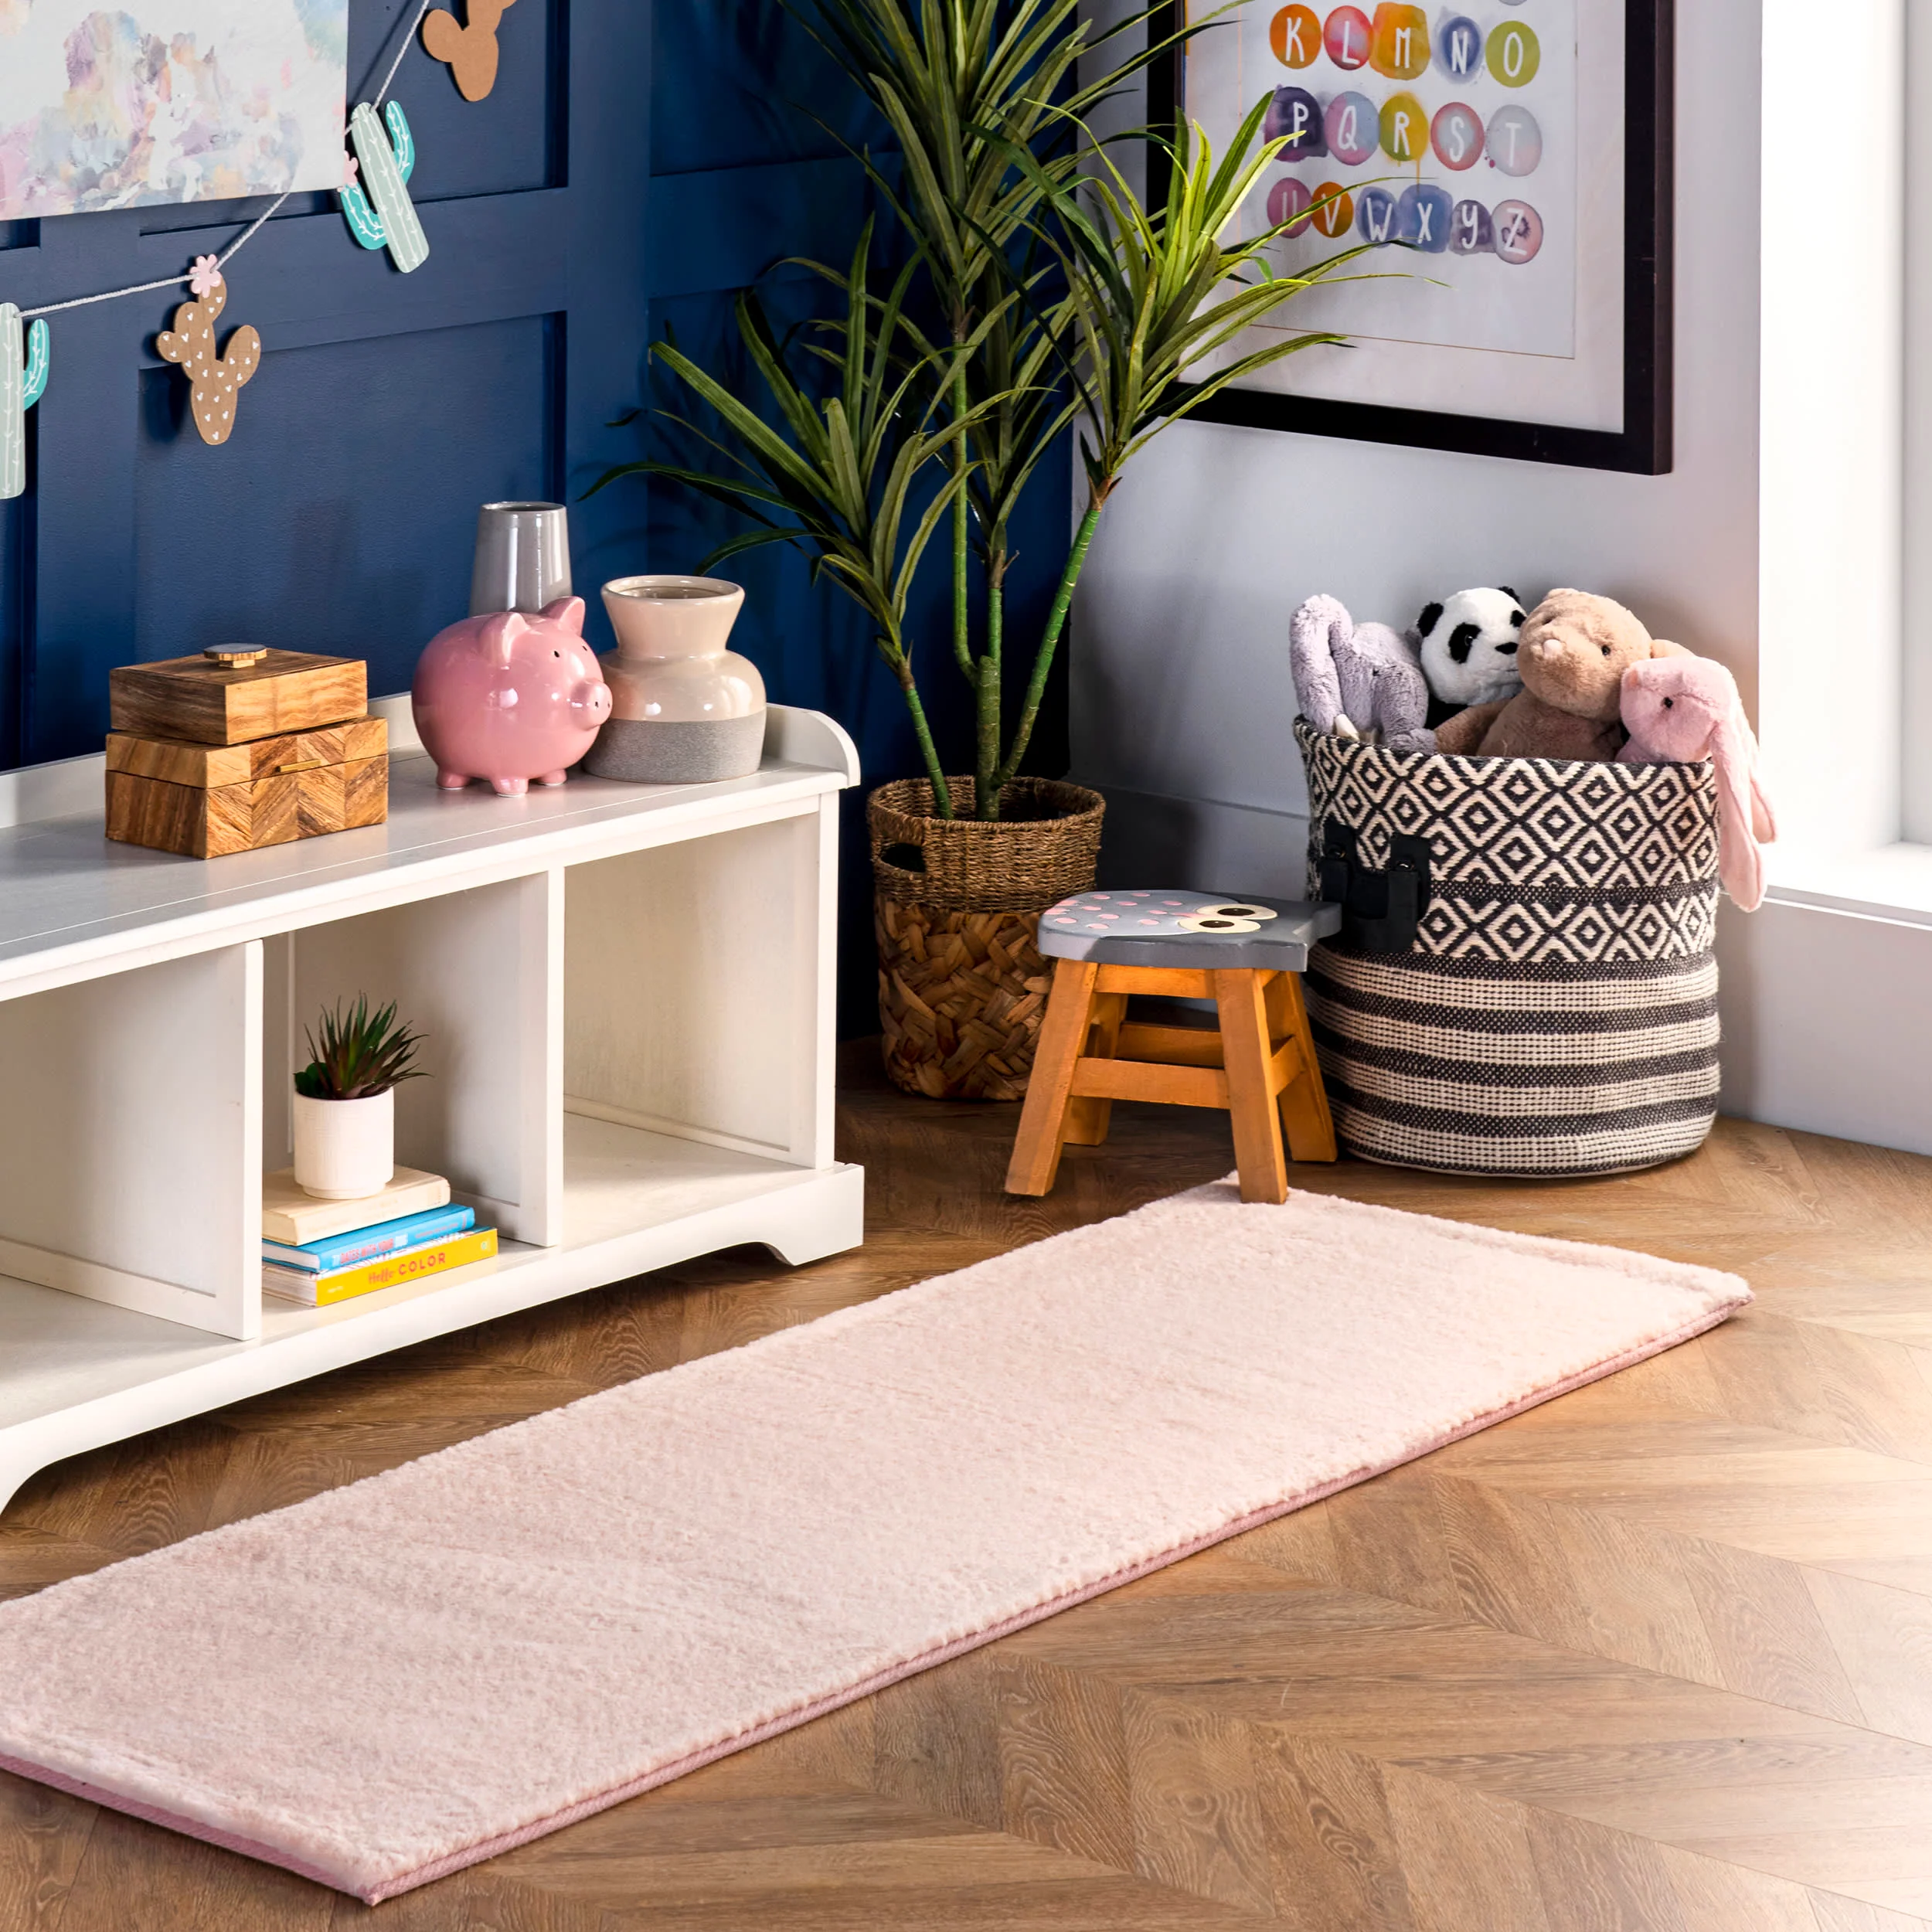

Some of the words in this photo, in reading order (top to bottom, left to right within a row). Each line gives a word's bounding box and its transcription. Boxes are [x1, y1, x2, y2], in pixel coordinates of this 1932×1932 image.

[1285, 17, 1304, 62] K
[1342, 21, 1360, 65] L
[1395, 27, 1411, 69] M
[1451, 31, 1468, 74] N
[1503, 32, 1523, 77] O
[1293, 101, 1309, 148] P
[1337, 105, 1358, 151] Q
[1393, 111, 1410, 156] R
[1449, 116, 1464, 163] S
[1505, 122, 1522, 168] T
[1321, 192, 1342, 235] V
[1366, 197, 1393, 242] W
[1417, 202, 1433, 244] X
[1504, 208, 1527, 256] Z
[398, 1252, 446, 1275] COLOR
